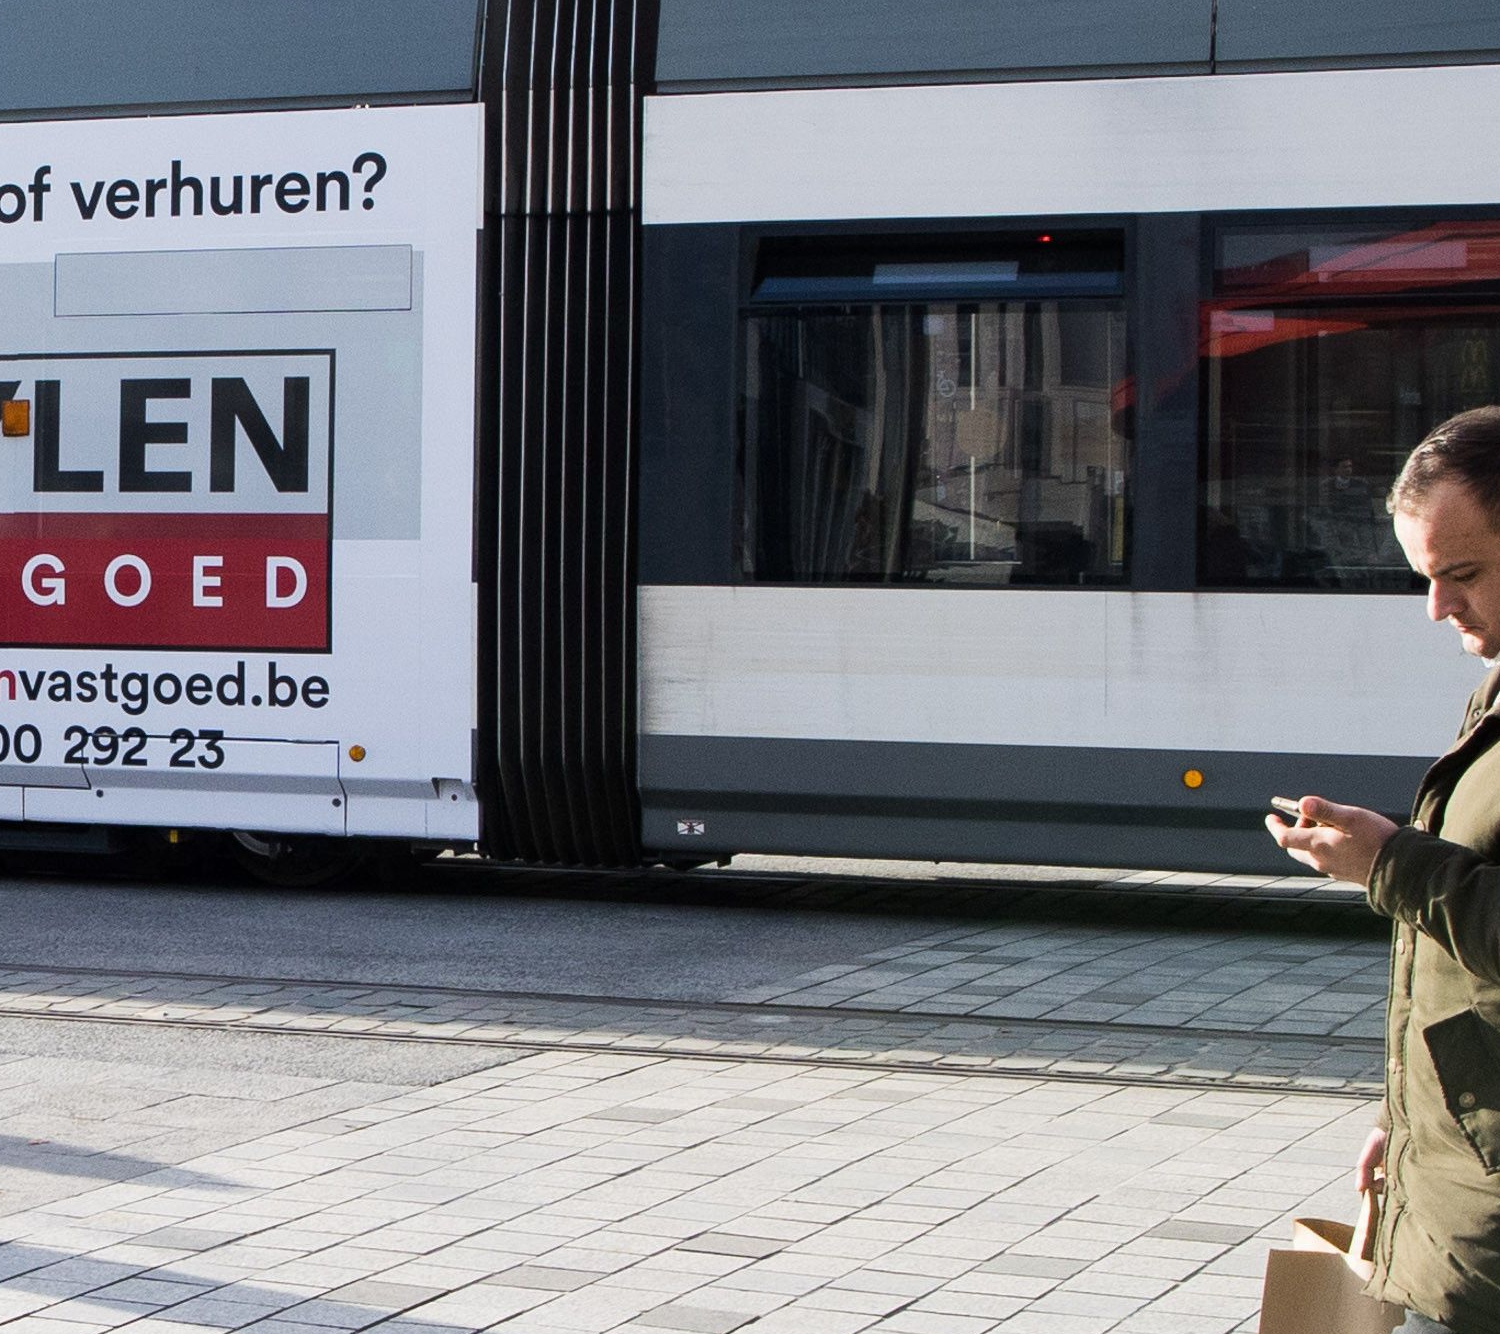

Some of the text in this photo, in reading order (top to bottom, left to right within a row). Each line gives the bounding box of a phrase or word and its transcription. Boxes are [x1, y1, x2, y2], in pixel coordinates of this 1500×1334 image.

[69, 152, 388, 220] verhuren?
[64, 724, 148, 767] 292
[169, 728, 225, 769] 23
